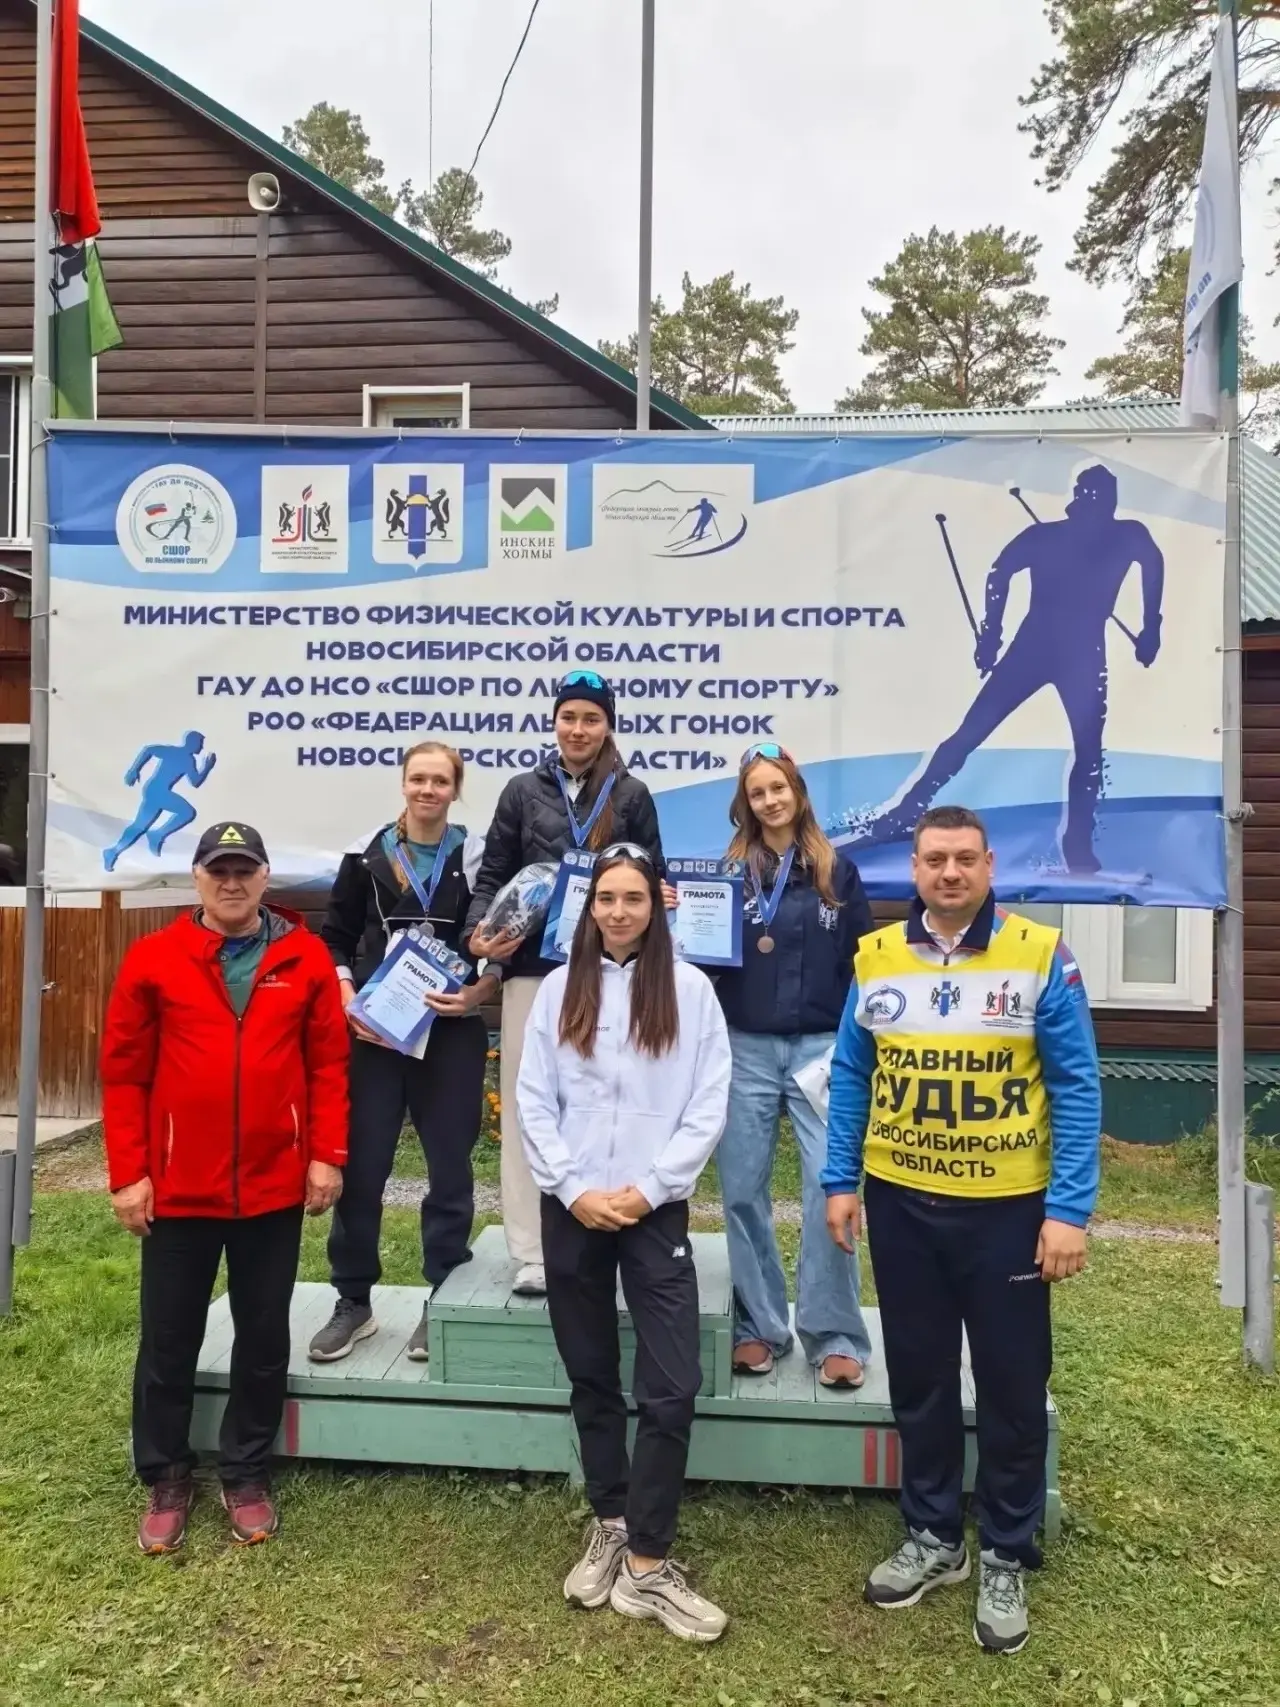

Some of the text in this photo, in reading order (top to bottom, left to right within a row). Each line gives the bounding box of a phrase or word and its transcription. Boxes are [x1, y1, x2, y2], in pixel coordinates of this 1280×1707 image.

[162, 545, 191, 556] СШОР
[500, 537, 554, 547] ИНСКИЕ
[503, 549, 552, 559] ХОЛМЫ
[124, 600, 906, 628] МИНИСТЕРСТВО ФИЗИЧЕСКОЙ КУЛЬТУРЫ И СПОРТА
[306, 636, 720, 663] НОВОСИБИРСКОЙ ОБЛАСТИ
[197, 676, 840, 699] ГАУ ДО НСО «СШОР ПО ЛНОМУ СПОРТУ»
[248, 711, 305, 731] РОО
[311, 711, 513, 735] «ФЕДЕРАЦИЯ
[670, 714, 774, 735] ГОНОК
[297, 743, 559, 768] НОВОСРСКОЙ
[683, 890, 726, 899] ГРАМОТА
[876, 938, 882, 950] 1
[1020, 928, 1028, 940] 1
[403, 960, 438, 990] ГРАМОТА
[875, 1070, 1030, 1129] СУДЬЯ
[892, 1150, 996, 1178] ОБЛАСТЬ
